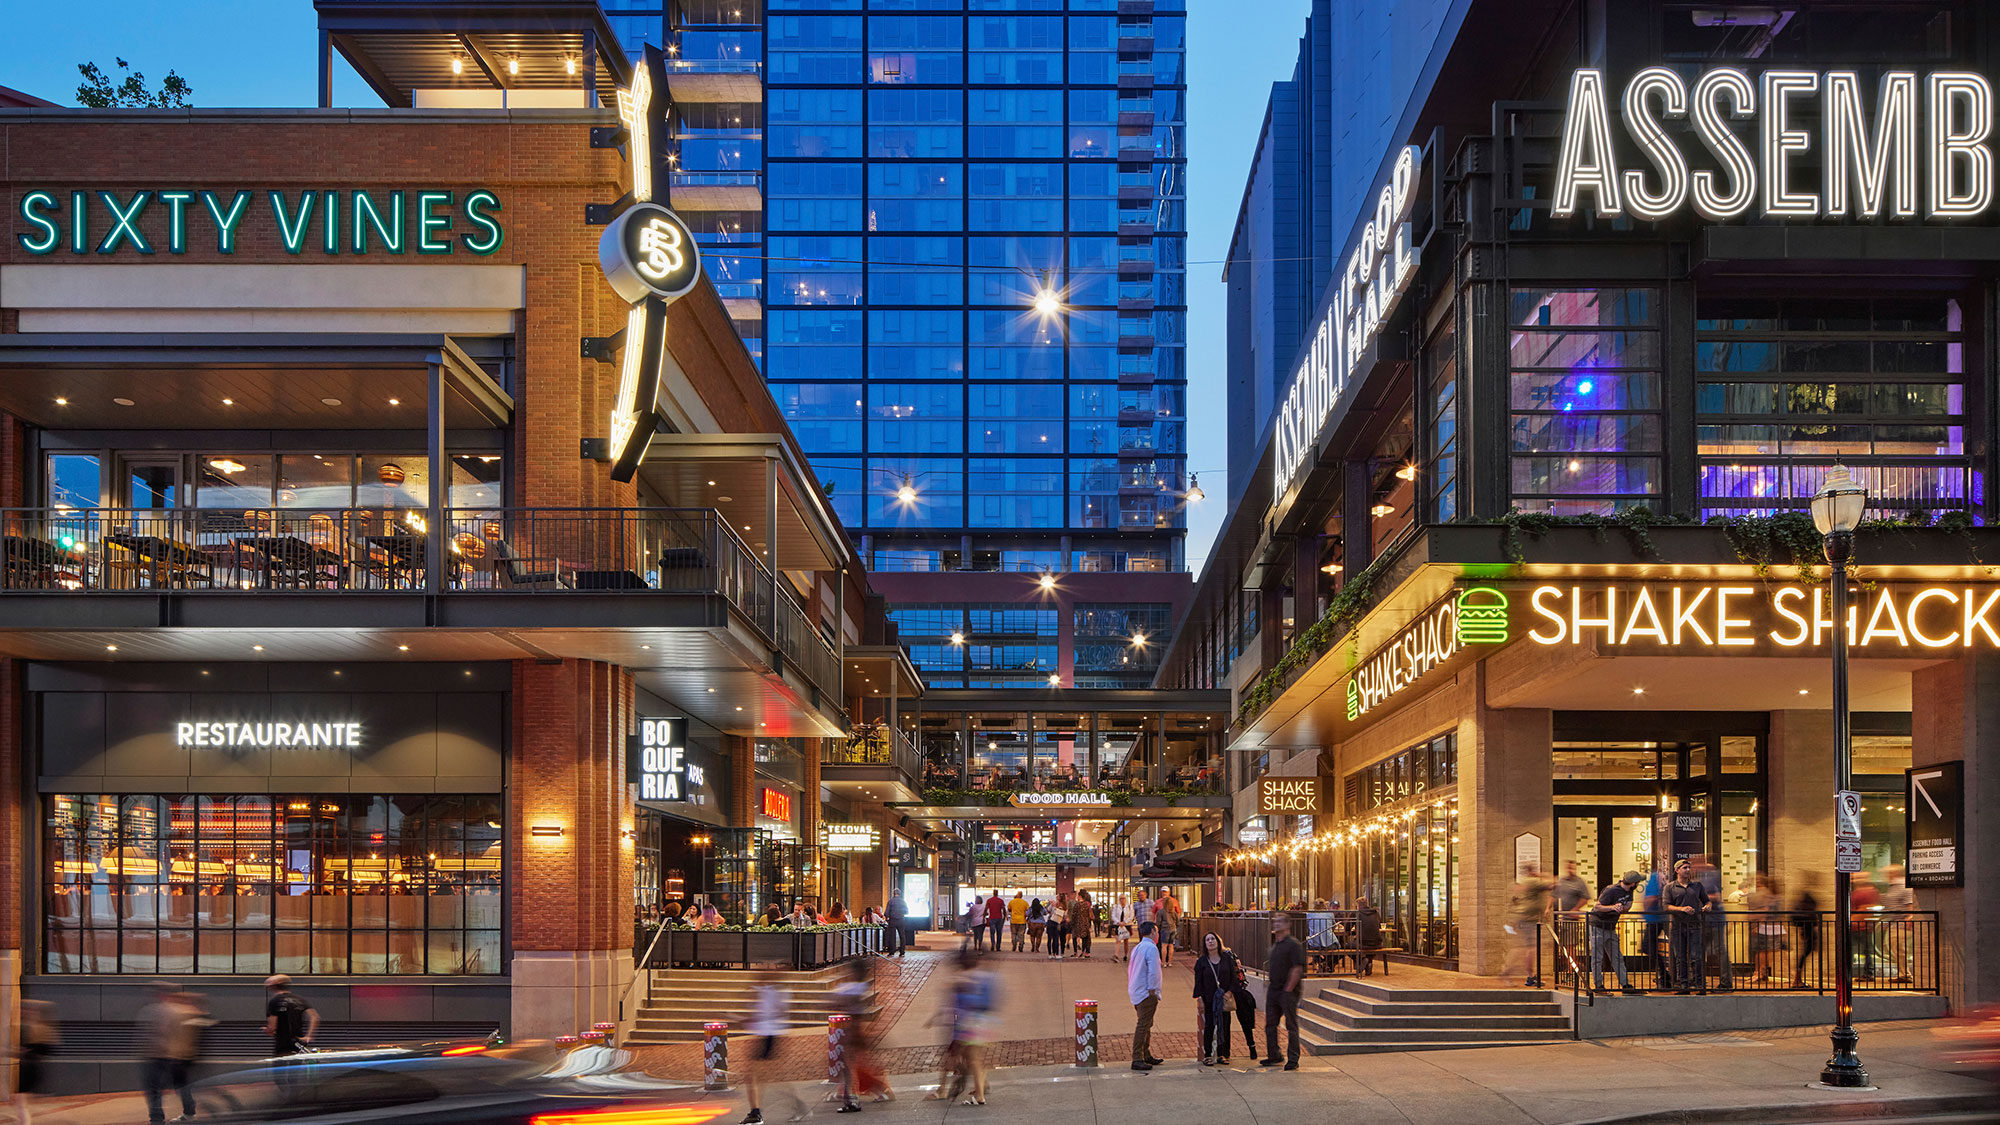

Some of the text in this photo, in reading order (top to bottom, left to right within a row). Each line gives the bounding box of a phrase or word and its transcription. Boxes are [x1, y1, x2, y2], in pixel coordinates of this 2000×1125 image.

[1550, 66, 1994, 220] ASSEMB
[17, 189, 504, 256] SIXTY VINES
[1346, 145, 1421, 316] FOOD
[1346, 221, 1421, 378] HALL
[1273, 272, 1347, 508] ASSEMBLY
[1528, 585, 2000, 648] SHAKE SHACK
[1358, 640, 1404, 714] SHAKE
[178, 722, 361, 747] RESTAURANTE
[642, 720, 671, 746] BO
[642, 747, 684, 773] QUE
[642, 773, 679, 799] RIA
[1020, 793, 1112, 804] FOOD HALL
[1264, 781, 1314, 796] SHAKE
[1264, 796, 1316, 810] SHACK
[828, 825, 872, 834] TECOVAS
[1676, 816, 1702, 828] ASSEMBLY
